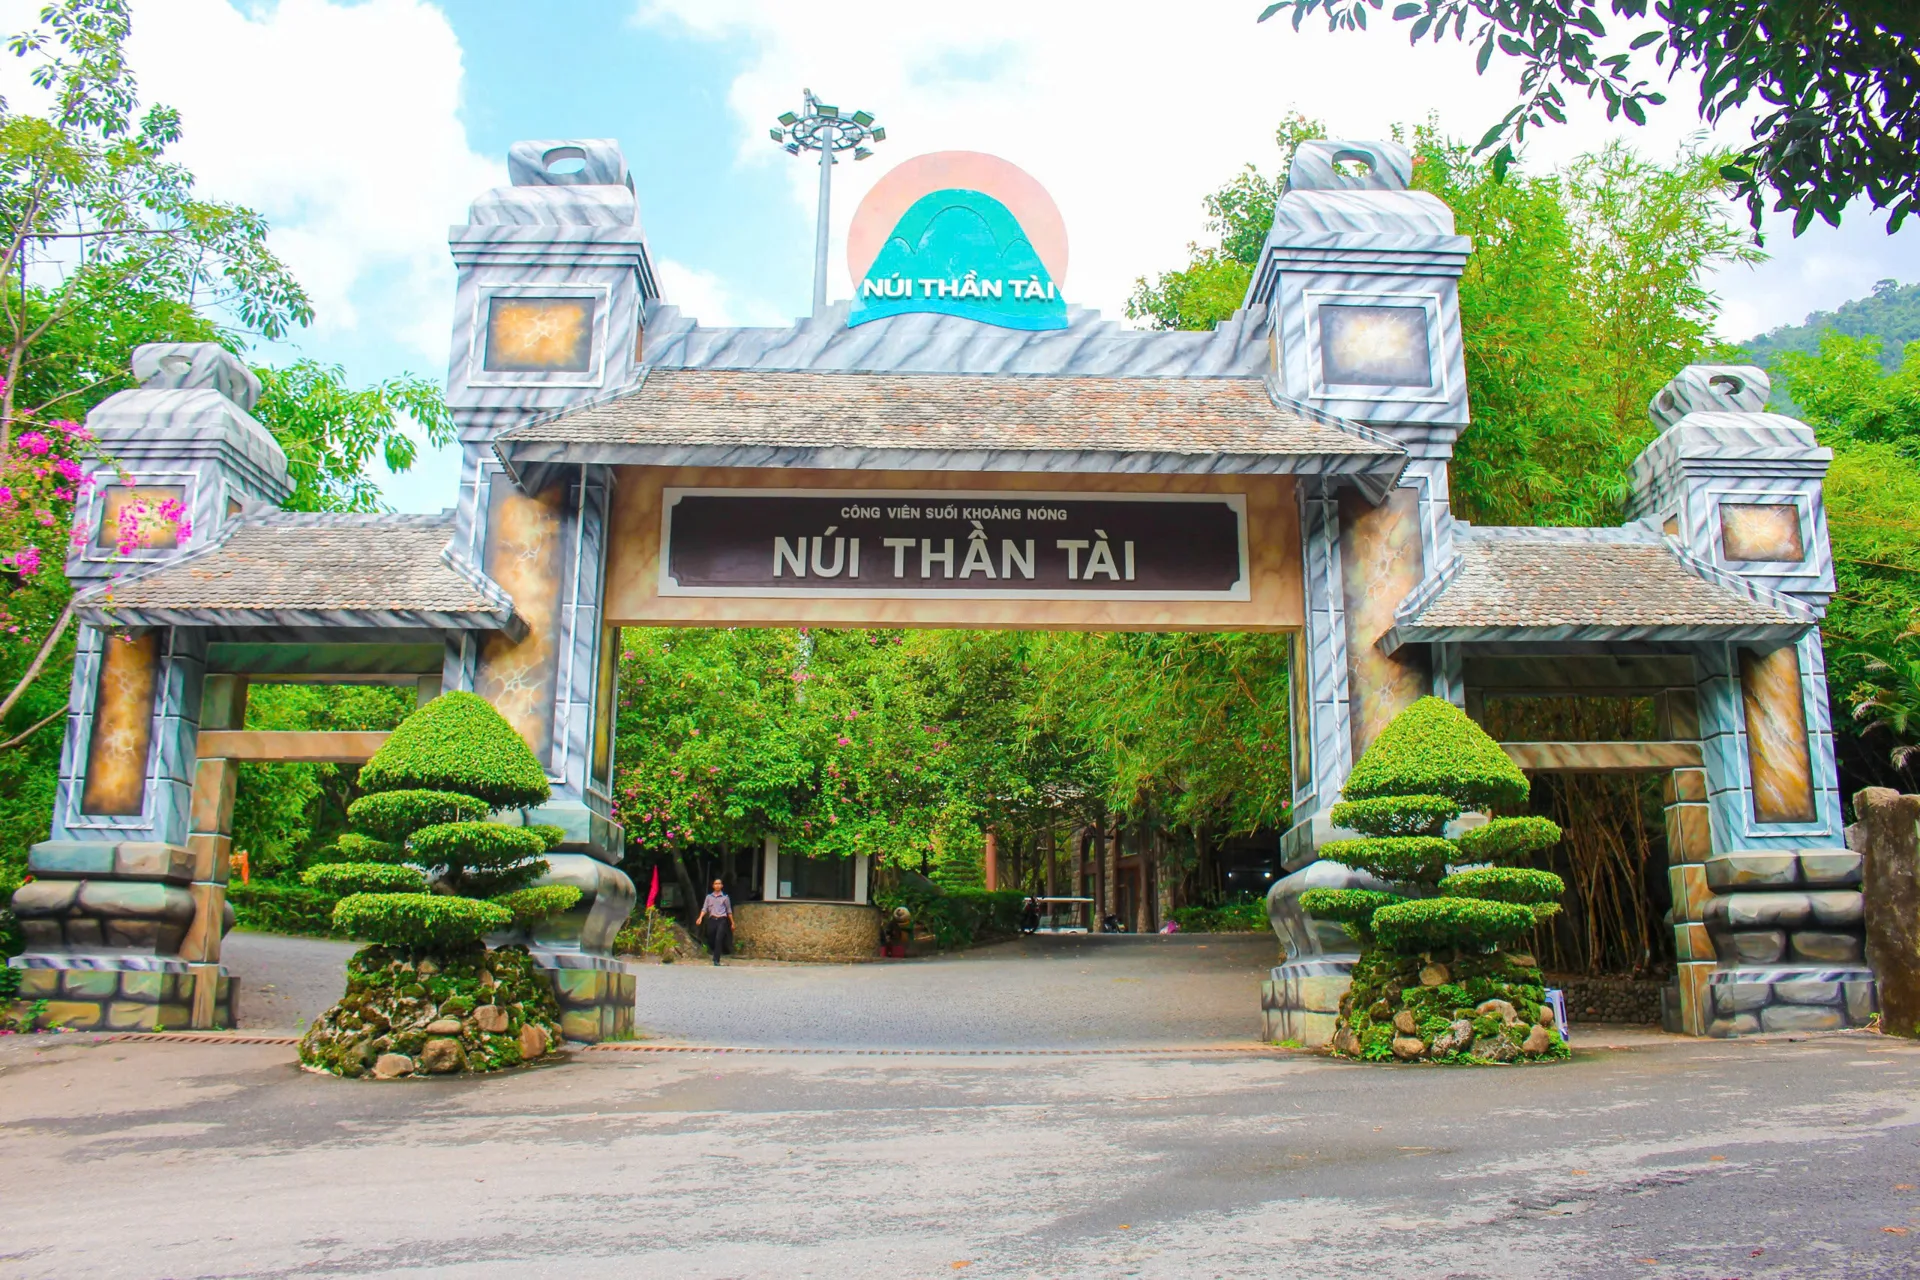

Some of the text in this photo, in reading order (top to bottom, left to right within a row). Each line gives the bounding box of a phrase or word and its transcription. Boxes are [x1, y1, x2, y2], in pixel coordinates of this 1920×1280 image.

[863, 269, 1055, 300] NÚI THẦN TÀI
[840, 504, 1068, 521] CÔNG VIÊN SUỐI KHOÁNG NÓNG
[773, 520, 1135, 581] NÚI THẦN TÀI
